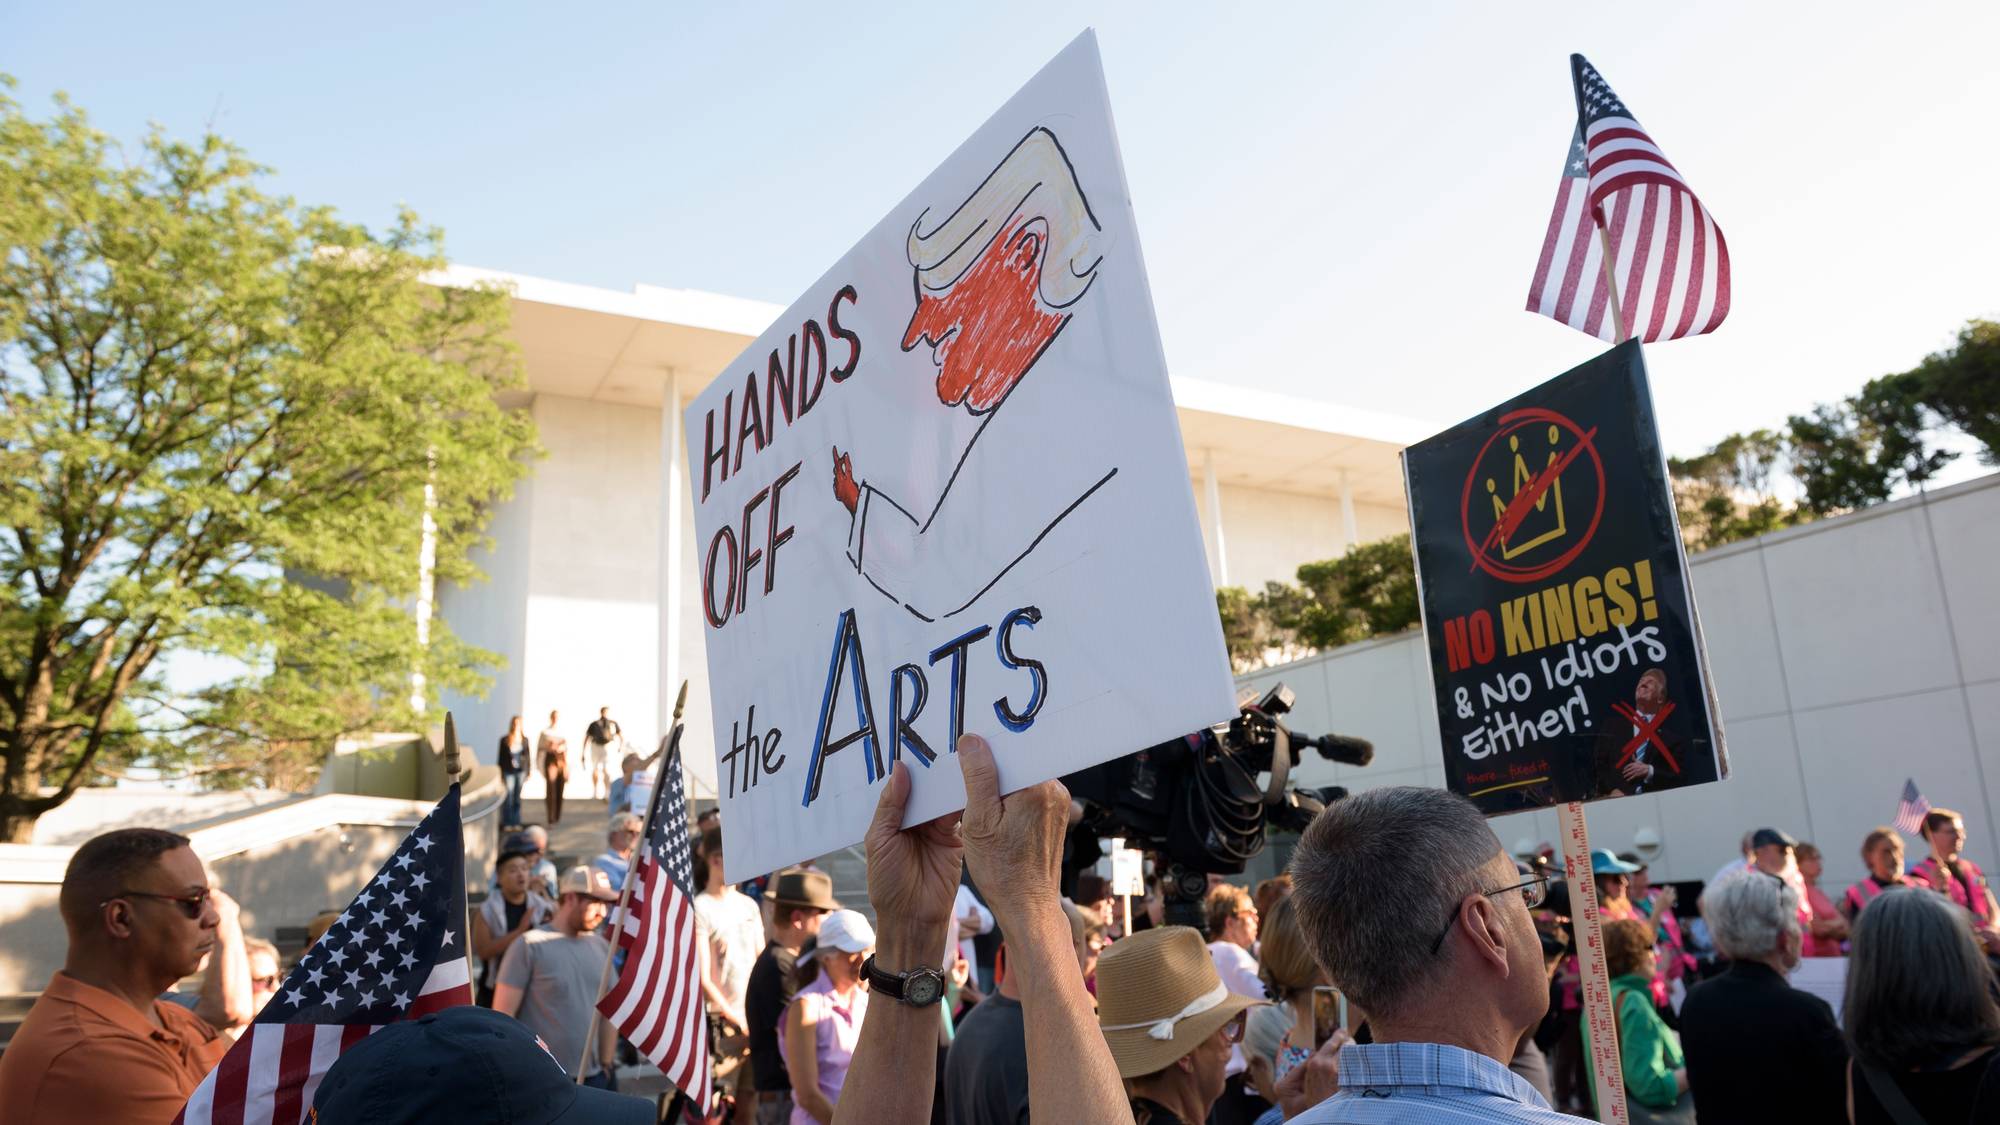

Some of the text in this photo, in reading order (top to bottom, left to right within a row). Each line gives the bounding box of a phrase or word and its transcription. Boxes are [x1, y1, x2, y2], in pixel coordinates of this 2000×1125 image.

[701, 285, 862, 503] HANDS
[703, 461, 802, 629] OFF
[1444, 559, 1659, 672] NO KINGS!
[722, 606, 1048, 808] the ARTS
[1454, 687, 1475, 720] &
[1540, 623, 1667, 690] Idiots
[1462, 686, 1592, 761] Either!
[1566, 855, 1575, 878] ACE
[1589, 1005, 1600, 1044] helpful
